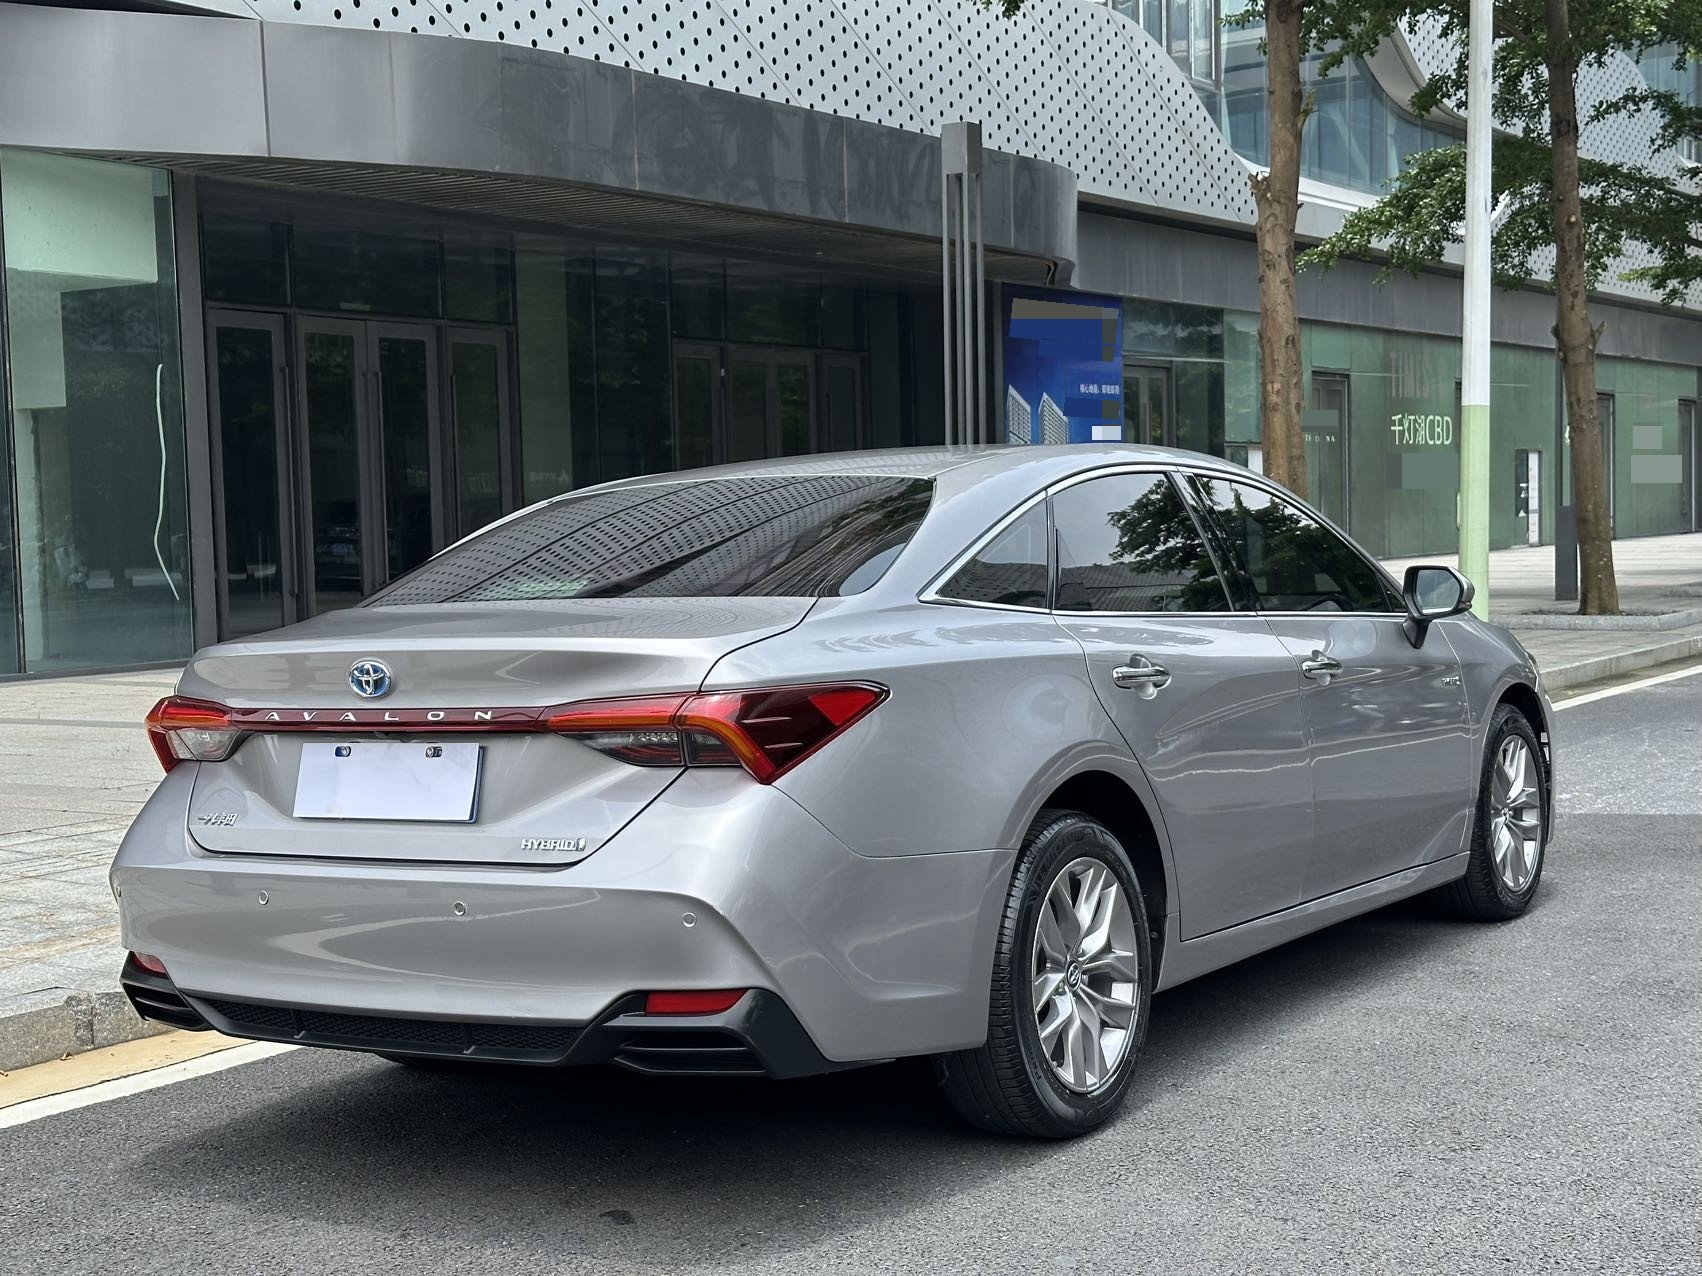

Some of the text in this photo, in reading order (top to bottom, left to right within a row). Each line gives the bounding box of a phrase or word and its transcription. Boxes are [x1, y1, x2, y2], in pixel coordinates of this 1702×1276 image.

[1390, 412, 1452, 446] 千灯湖CBD
[265, 711, 492, 721] AVALON
[520, 838, 577, 851] HYBRID
